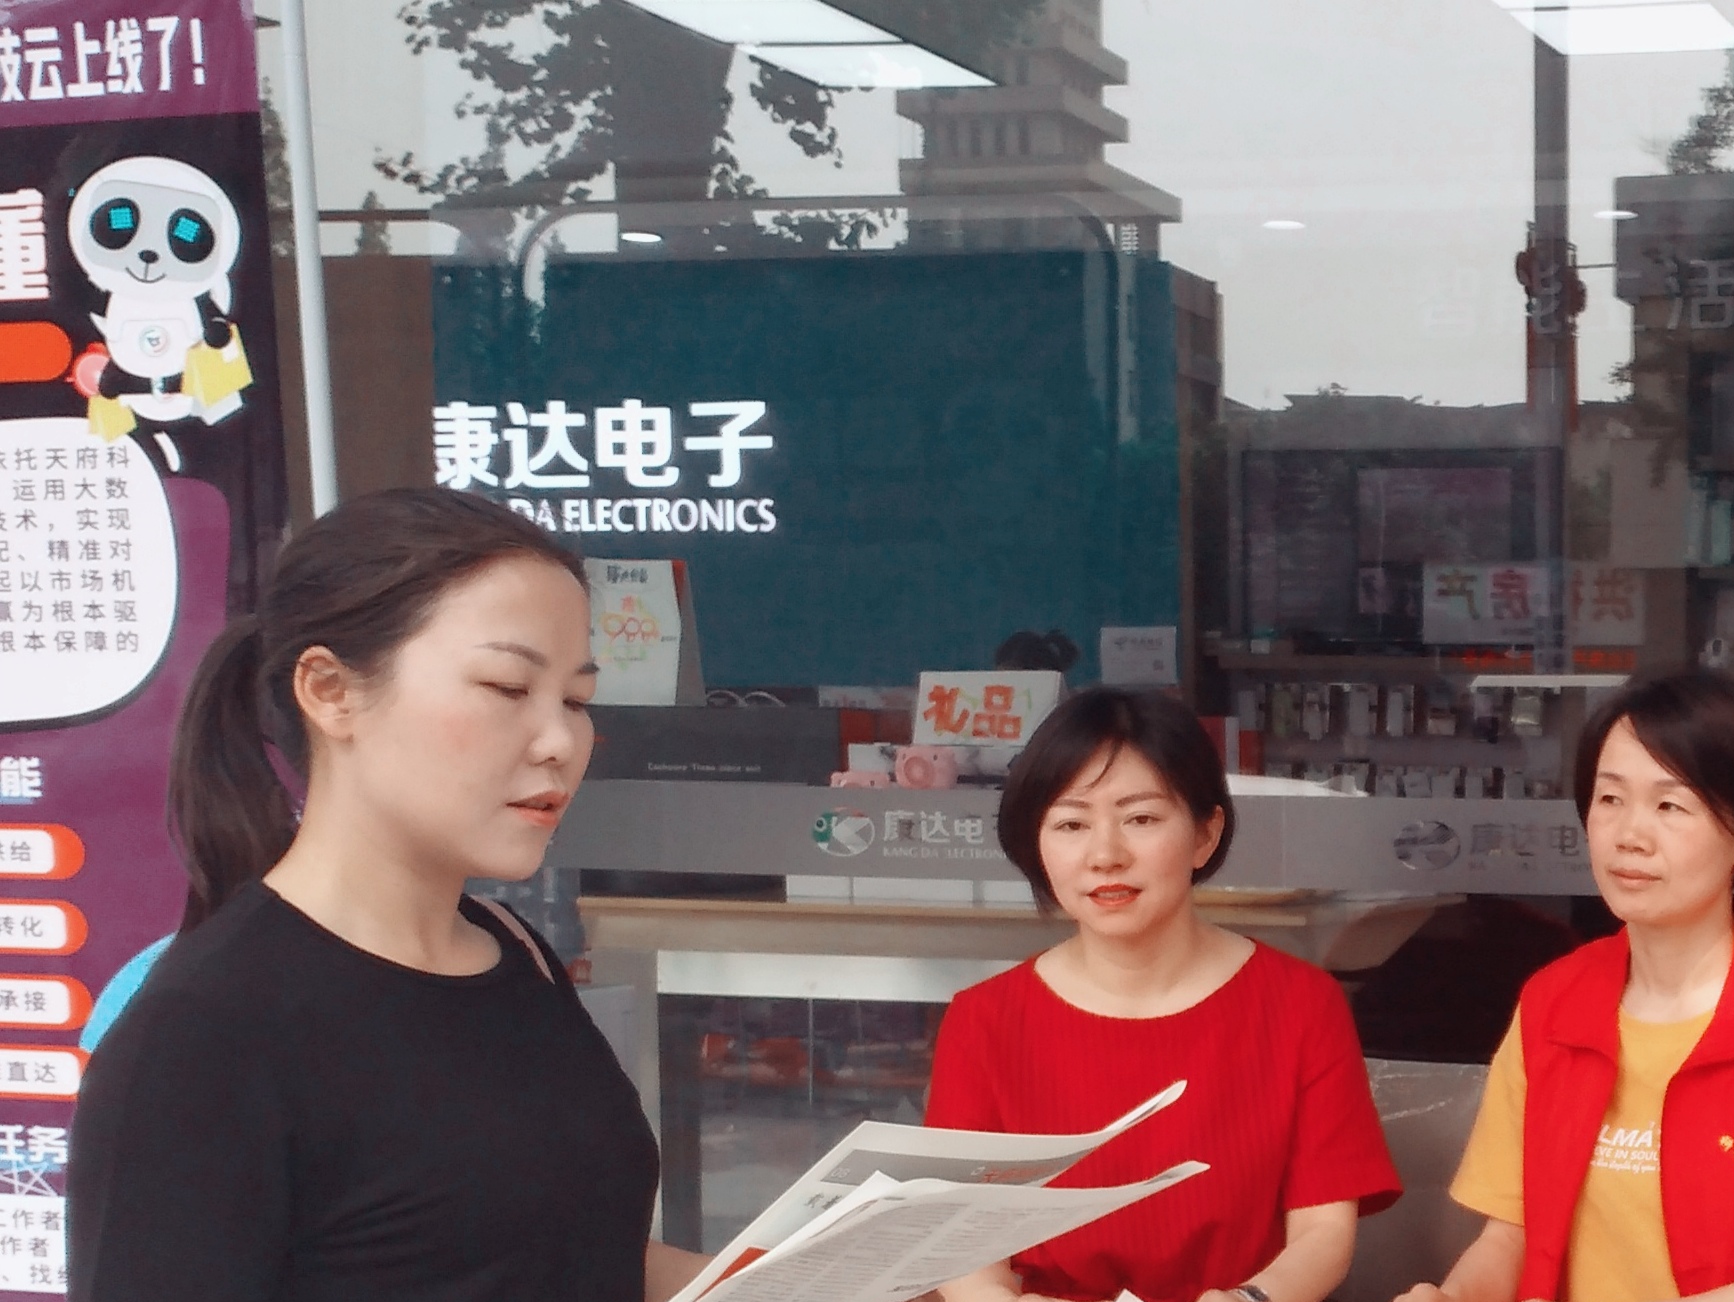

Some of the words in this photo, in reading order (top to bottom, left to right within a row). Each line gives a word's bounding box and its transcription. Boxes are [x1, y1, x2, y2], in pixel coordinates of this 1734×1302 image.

[432, 399, 774, 490] 康达电子
[0, 446, 129, 472] 托天府科
[12, 477, 129, 501] 运用大数
[0, 508, 131, 532] 术，实现
[562, 499, 777, 533] ELECTRONICS
[924, 685, 1025, 742] 礼品
[884, 810, 998, 844] 康达电
[0, 841, 31, 862] 给
[0, 989, 47, 1012] 承接
[1614, 1149, 1629, 1160] IN
